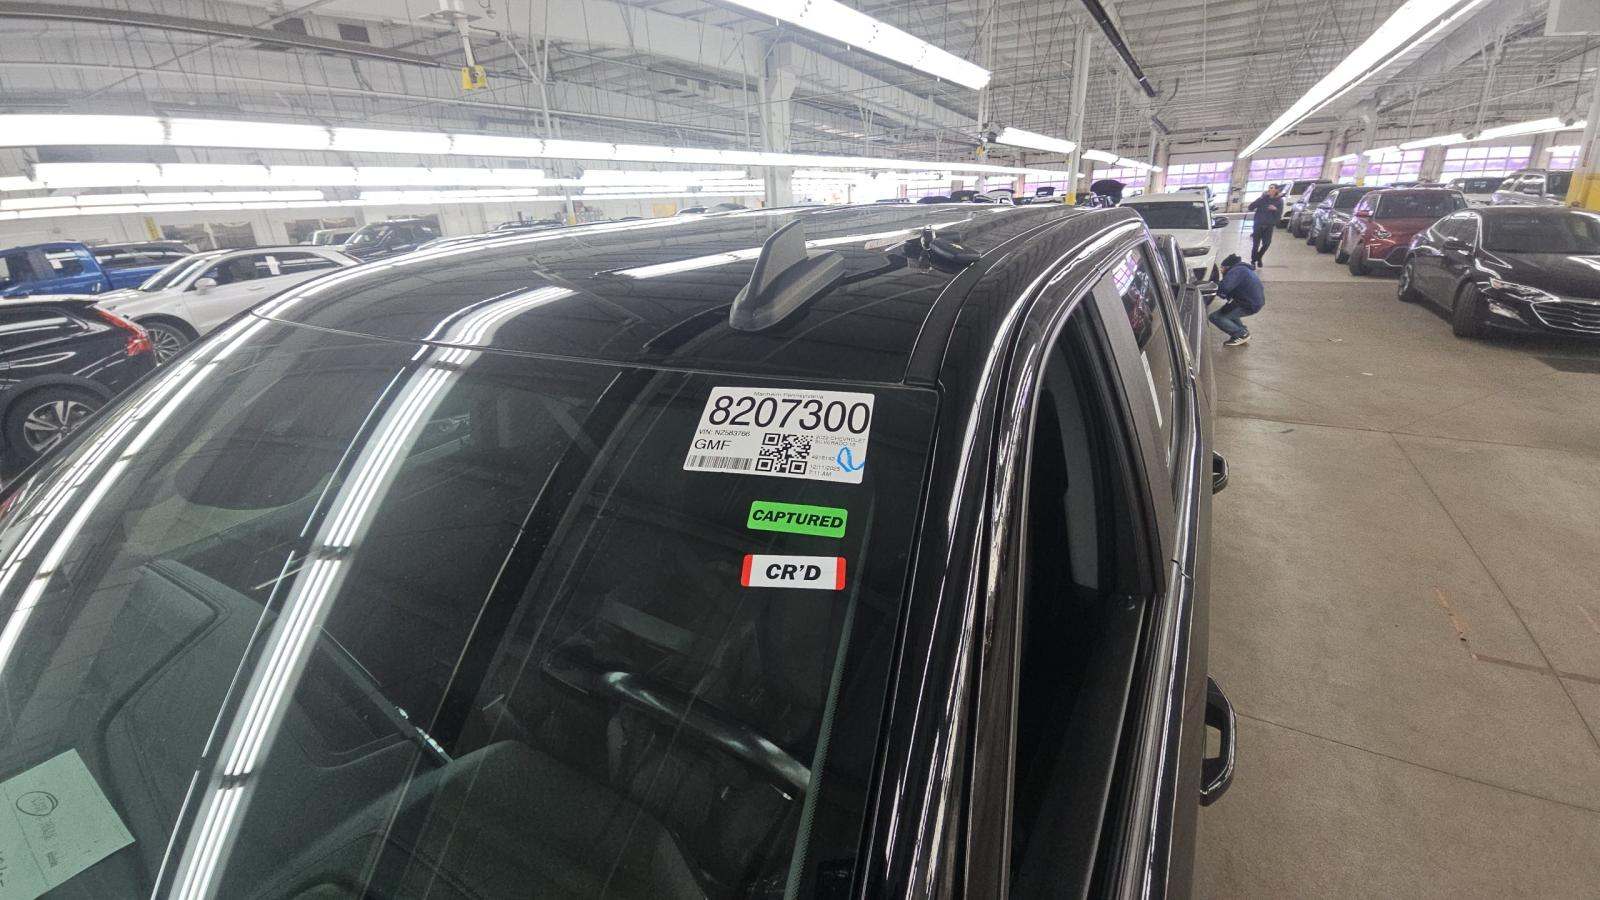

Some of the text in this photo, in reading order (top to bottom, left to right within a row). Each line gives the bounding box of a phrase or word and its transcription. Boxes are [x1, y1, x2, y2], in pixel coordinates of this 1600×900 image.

[709, 395, 871, 435] 8207300
[694, 439, 732, 450] GMF
[752, 509, 844, 528] CAPTURED
[766, 563, 821, 581] CR'D
